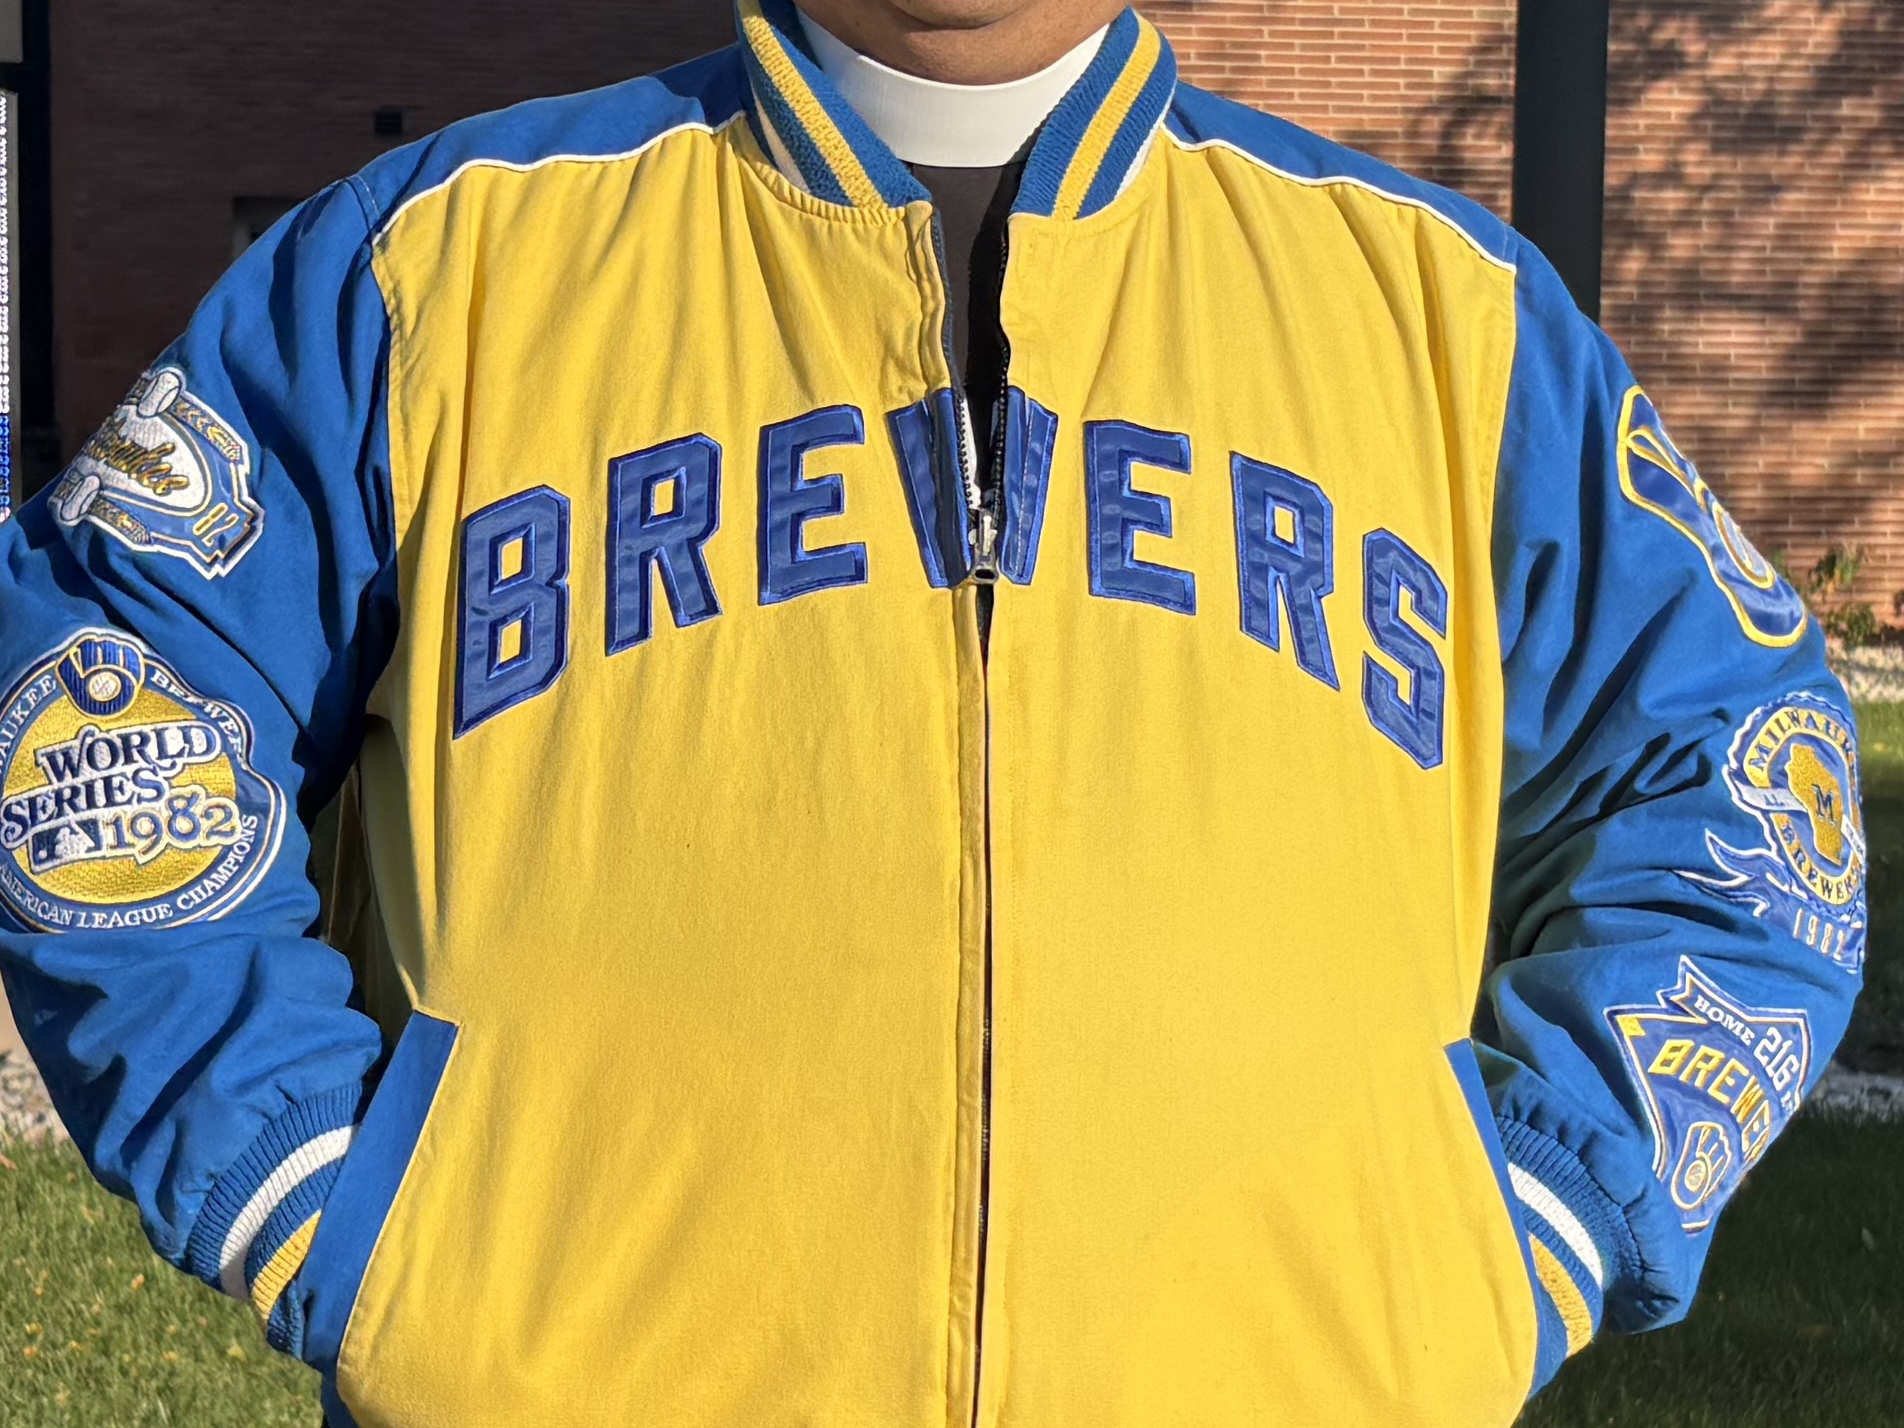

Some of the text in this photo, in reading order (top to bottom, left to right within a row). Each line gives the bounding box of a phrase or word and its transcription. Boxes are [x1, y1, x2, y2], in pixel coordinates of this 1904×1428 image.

[452, 386, 1448, 771] BREWERS
[35, 723, 220, 785] WORLD
[0, 769, 167, 845] SERIES
[106, 789, 241, 859] 1982
[76, 902, 175, 929] LEAGUE
[176, 813, 259, 911] CHAMPIONS
[1792, 907, 1847, 962] 1982
[1693, 995, 1801, 1092] HOME 216
